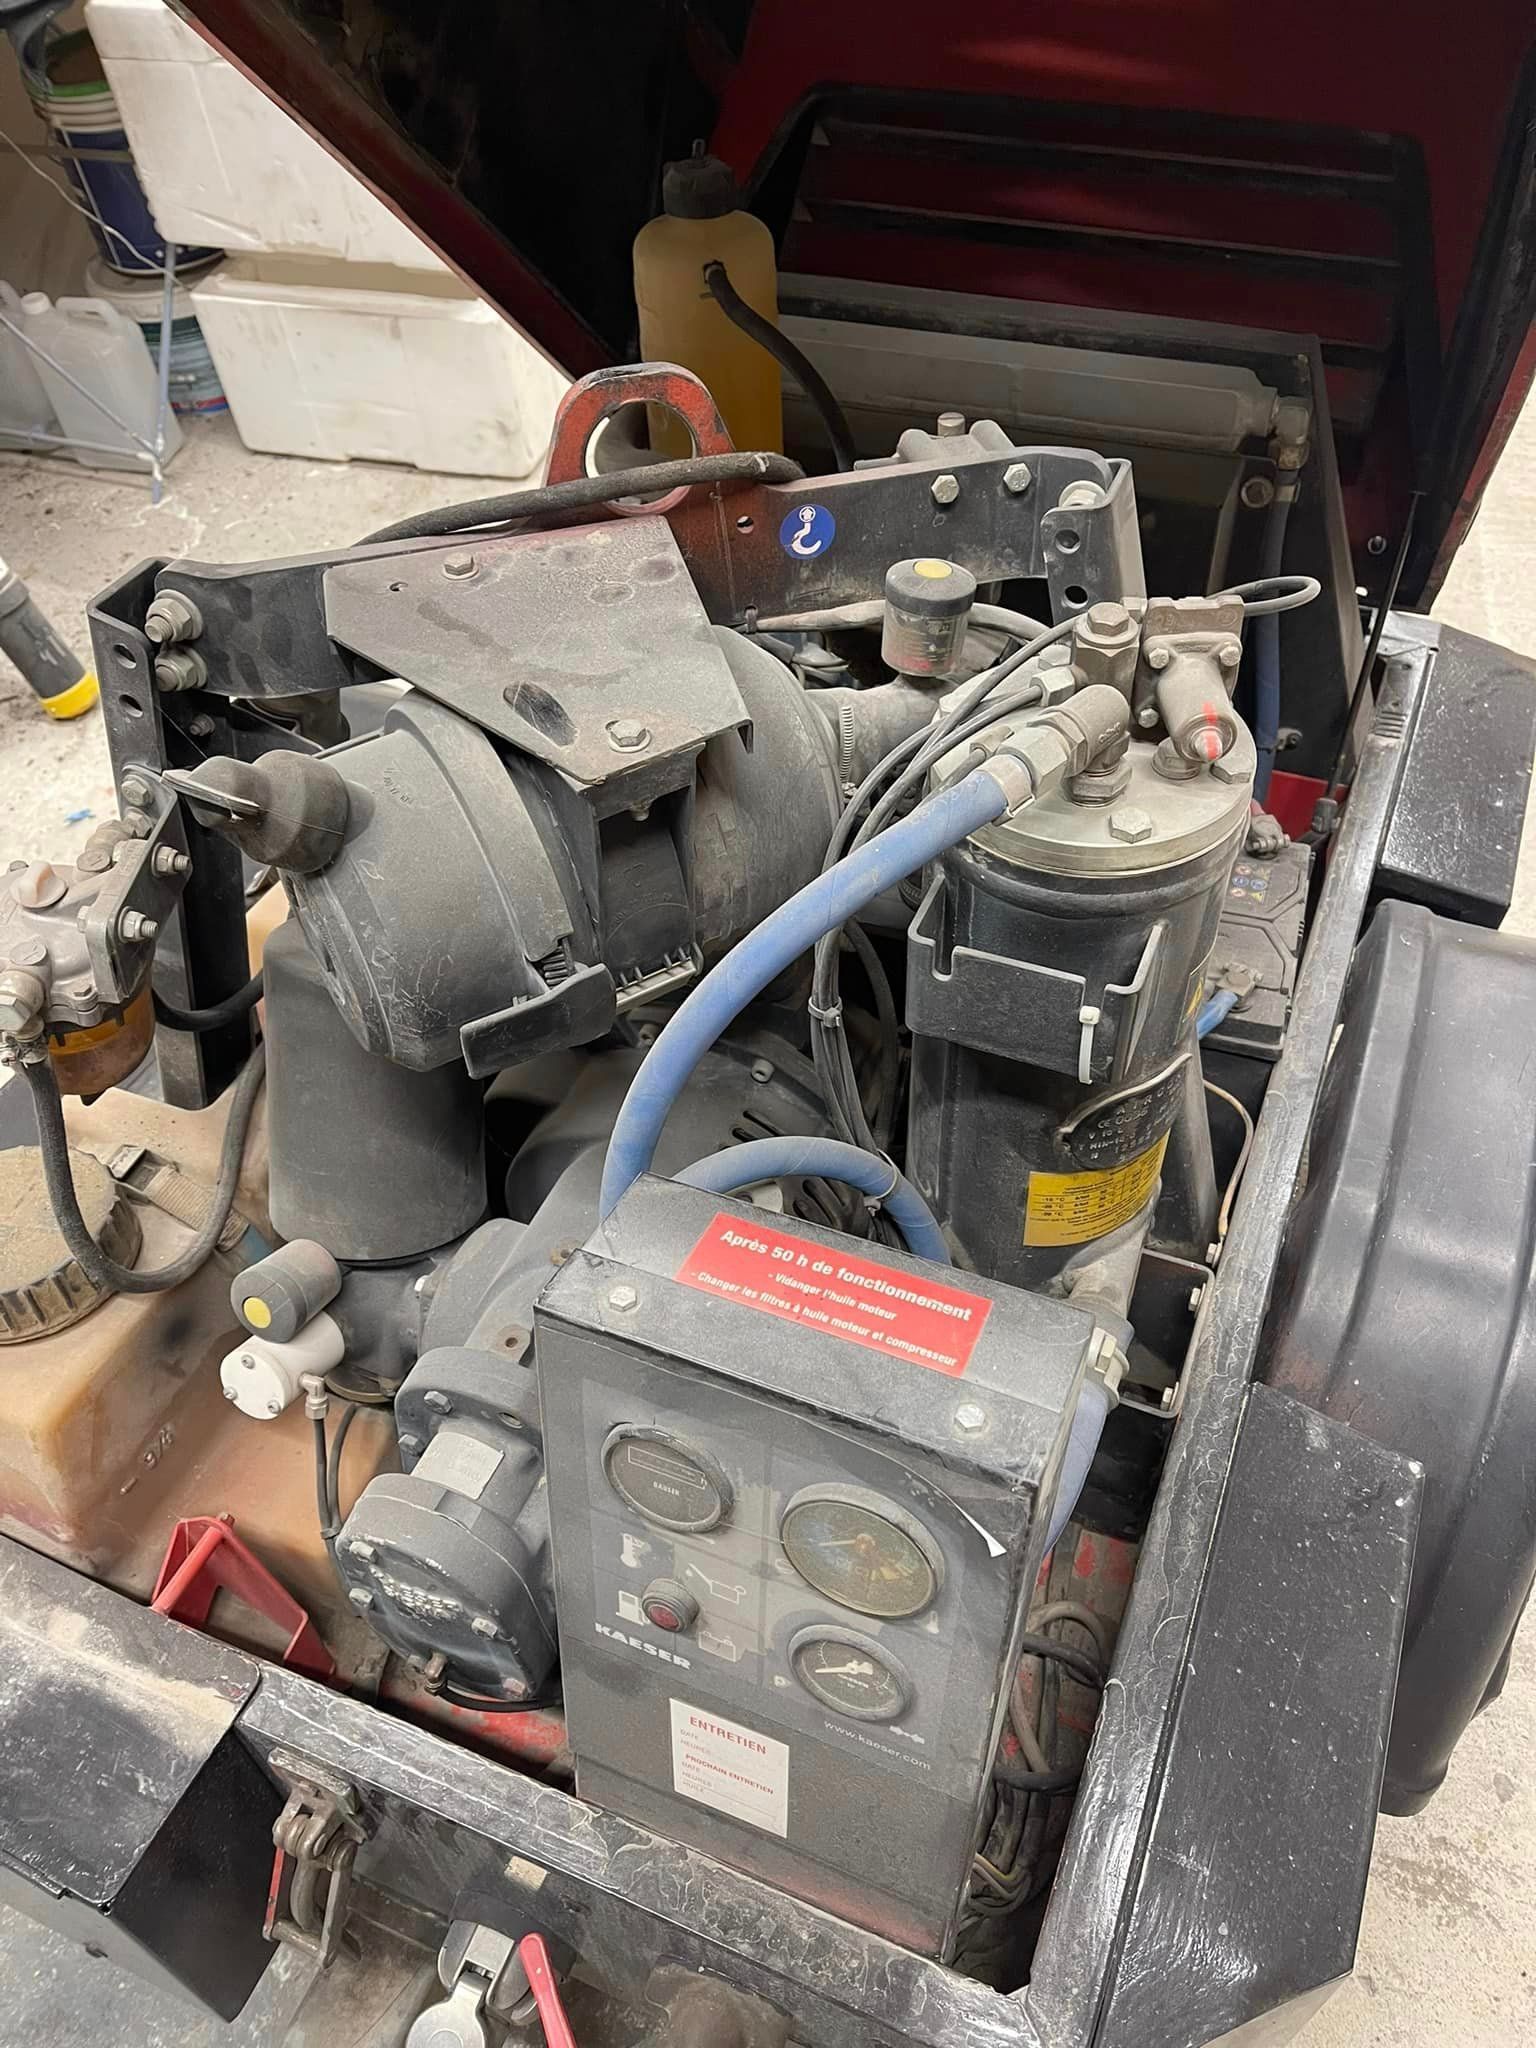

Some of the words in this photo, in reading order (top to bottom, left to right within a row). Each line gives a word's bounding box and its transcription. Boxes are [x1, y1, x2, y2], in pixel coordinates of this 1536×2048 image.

[720, 1229, 768, 1255] Après
[771, 1246, 794, 1263] 50
[796, 1254, 809, 1268] h
[812, 1258, 832, 1276] de
[836, 1266, 973, 1321] fonctionnement
[775, 1273, 821, 1298] Vidanger
[857, 1301, 897, 1321] moteur
[697, 1272, 740, 1293] Changer
[742, 1285, 757, 1299] les
[759, 1291, 791, 1312] filtres
[802, 1306, 829, 1325] huile
[831, 1316, 870, 1337] moteur
[871, 1329, 884, 1342] et
[885, 1335, 957, 1367] compresseur
[595, 1622, 691, 1670] KAESER
[689, 1716, 767, 1755] ENTRETIEN
[824, 1721, 931, 1771] www.kaeser.com
[686, 1753, 727, 1775] PROCHAIN
[729, 1771, 774, 1795] ENTRETIEN
